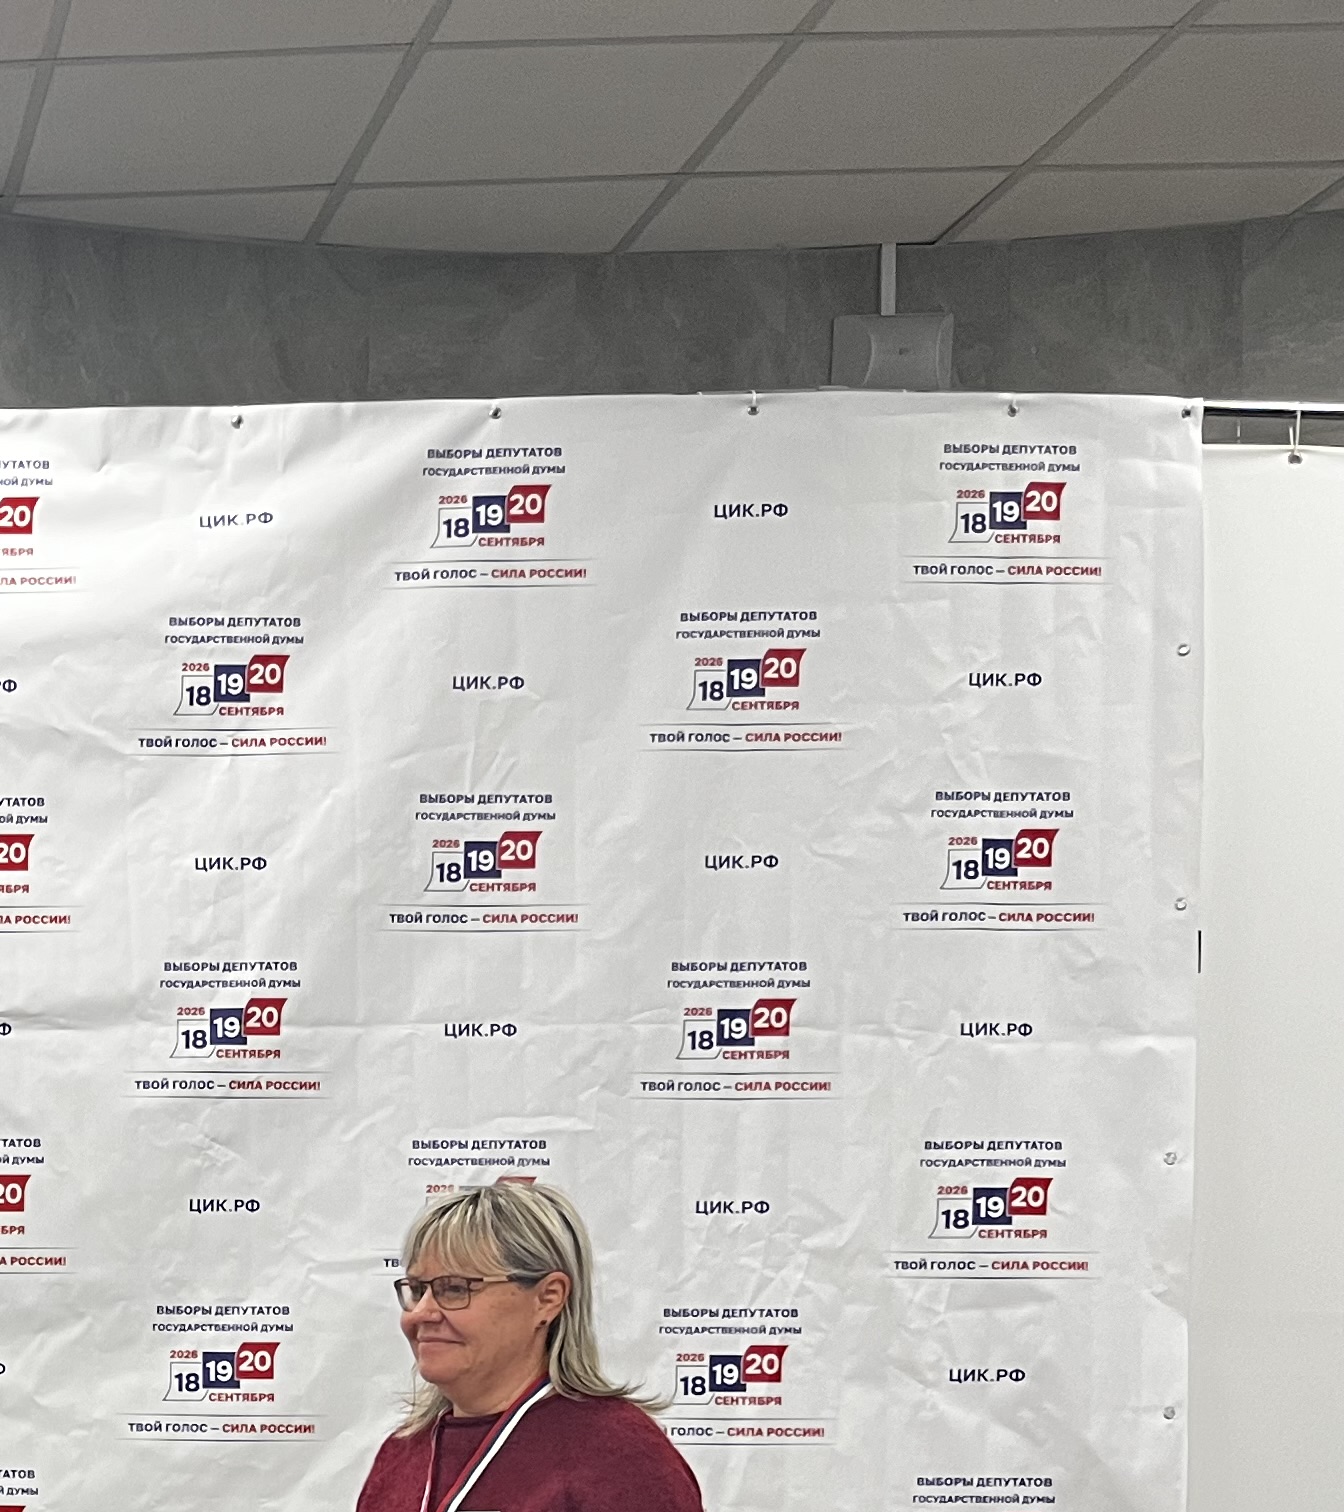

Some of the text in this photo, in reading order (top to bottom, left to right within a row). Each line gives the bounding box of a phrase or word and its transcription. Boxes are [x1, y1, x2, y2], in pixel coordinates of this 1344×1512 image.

[944, 444, 1076, 455] ВЫБОРЫ ДЕПУТАТОВ
[940, 461, 1080, 472] ГОСУДАРСТВЕННОЙ ДУМЫ
[713, 502, 788, 519] ЦИК.РФ
[961, 491, 1057, 533] 18 19 20
[199, 510, 274, 529] ЦИК.РФ
[995, 534, 1060, 543] СЕНТЯБРЯ
[913, 564, 1101, 576] ТВОЙ ГОЛОС СИЛА РОССИИ!
[169, 618, 301, 627] ВЫБОРЫ ДЕПУТАТОВ
[165, 634, 304, 644] ГОСУДАРСТВЕННОЙ ДУМЫ
[186, 664, 281, 706] 18 19 20
[968, 672, 1042, 688] ЦИК.РФ
[219, 707, 284, 715] СЕНТЯБРЯ
[138, 736, 326, 747] ТВОЙ ГОЛОС СИЛА РОССИИ!
[194, 856, 267, 873] ЦИК.РФ
[704, 854, 779, 870] ЦИК.РФ
[444, 1023, 517, 1038] ЦИК.РФ
[960, 1022, 1033, 1038] ЦИК.РФ
[695, 1199, 770, 1216] ЦИК.РФ
[11, 1257, 66, 1266] РОССИИ!
[949, 1368, 1026, 1384] ЦИК.РФ
[917, 1478, 1053, 1487] ВЫБОРЫ ДЕПУТАТОВ
[913, 1494, 1055, 1504] ГОСУДАРСТВЕННОЙ ДУМЫ
